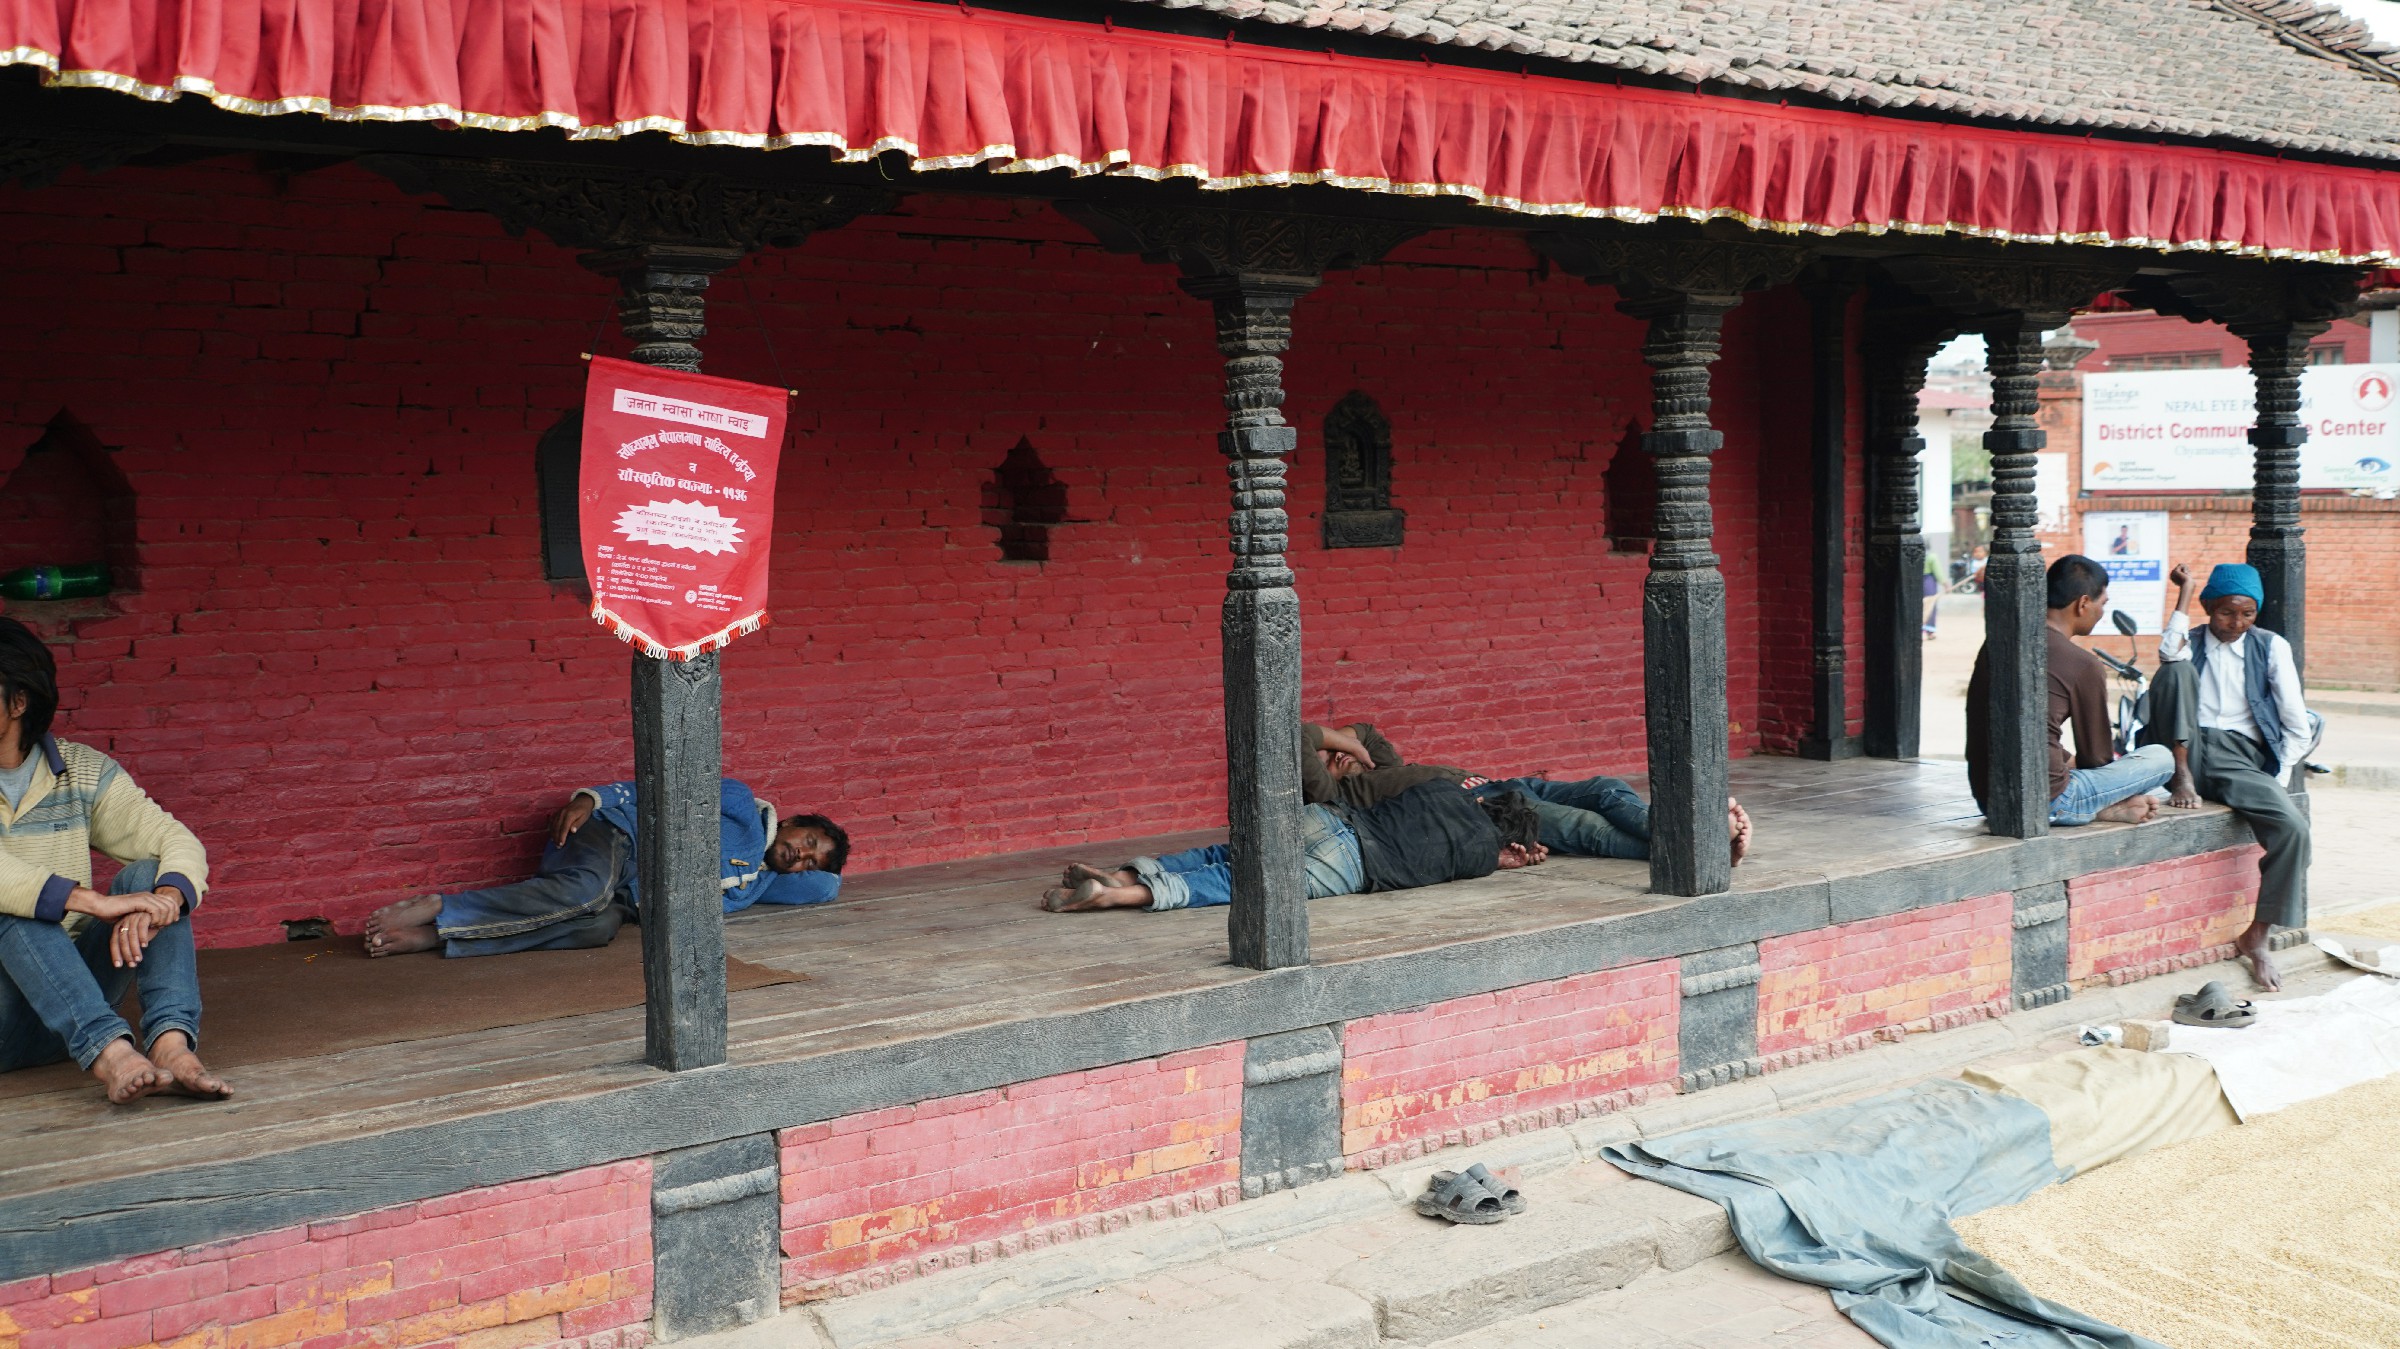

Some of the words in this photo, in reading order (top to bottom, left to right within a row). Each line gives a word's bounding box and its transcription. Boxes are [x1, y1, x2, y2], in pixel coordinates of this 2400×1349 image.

[2164, 400, 2206, 413] NEPAL
[2211, 399, 2240, 412] EYE
[2098, 423, 2164, 441] District
[2321, 418, 2388, 437] Center
